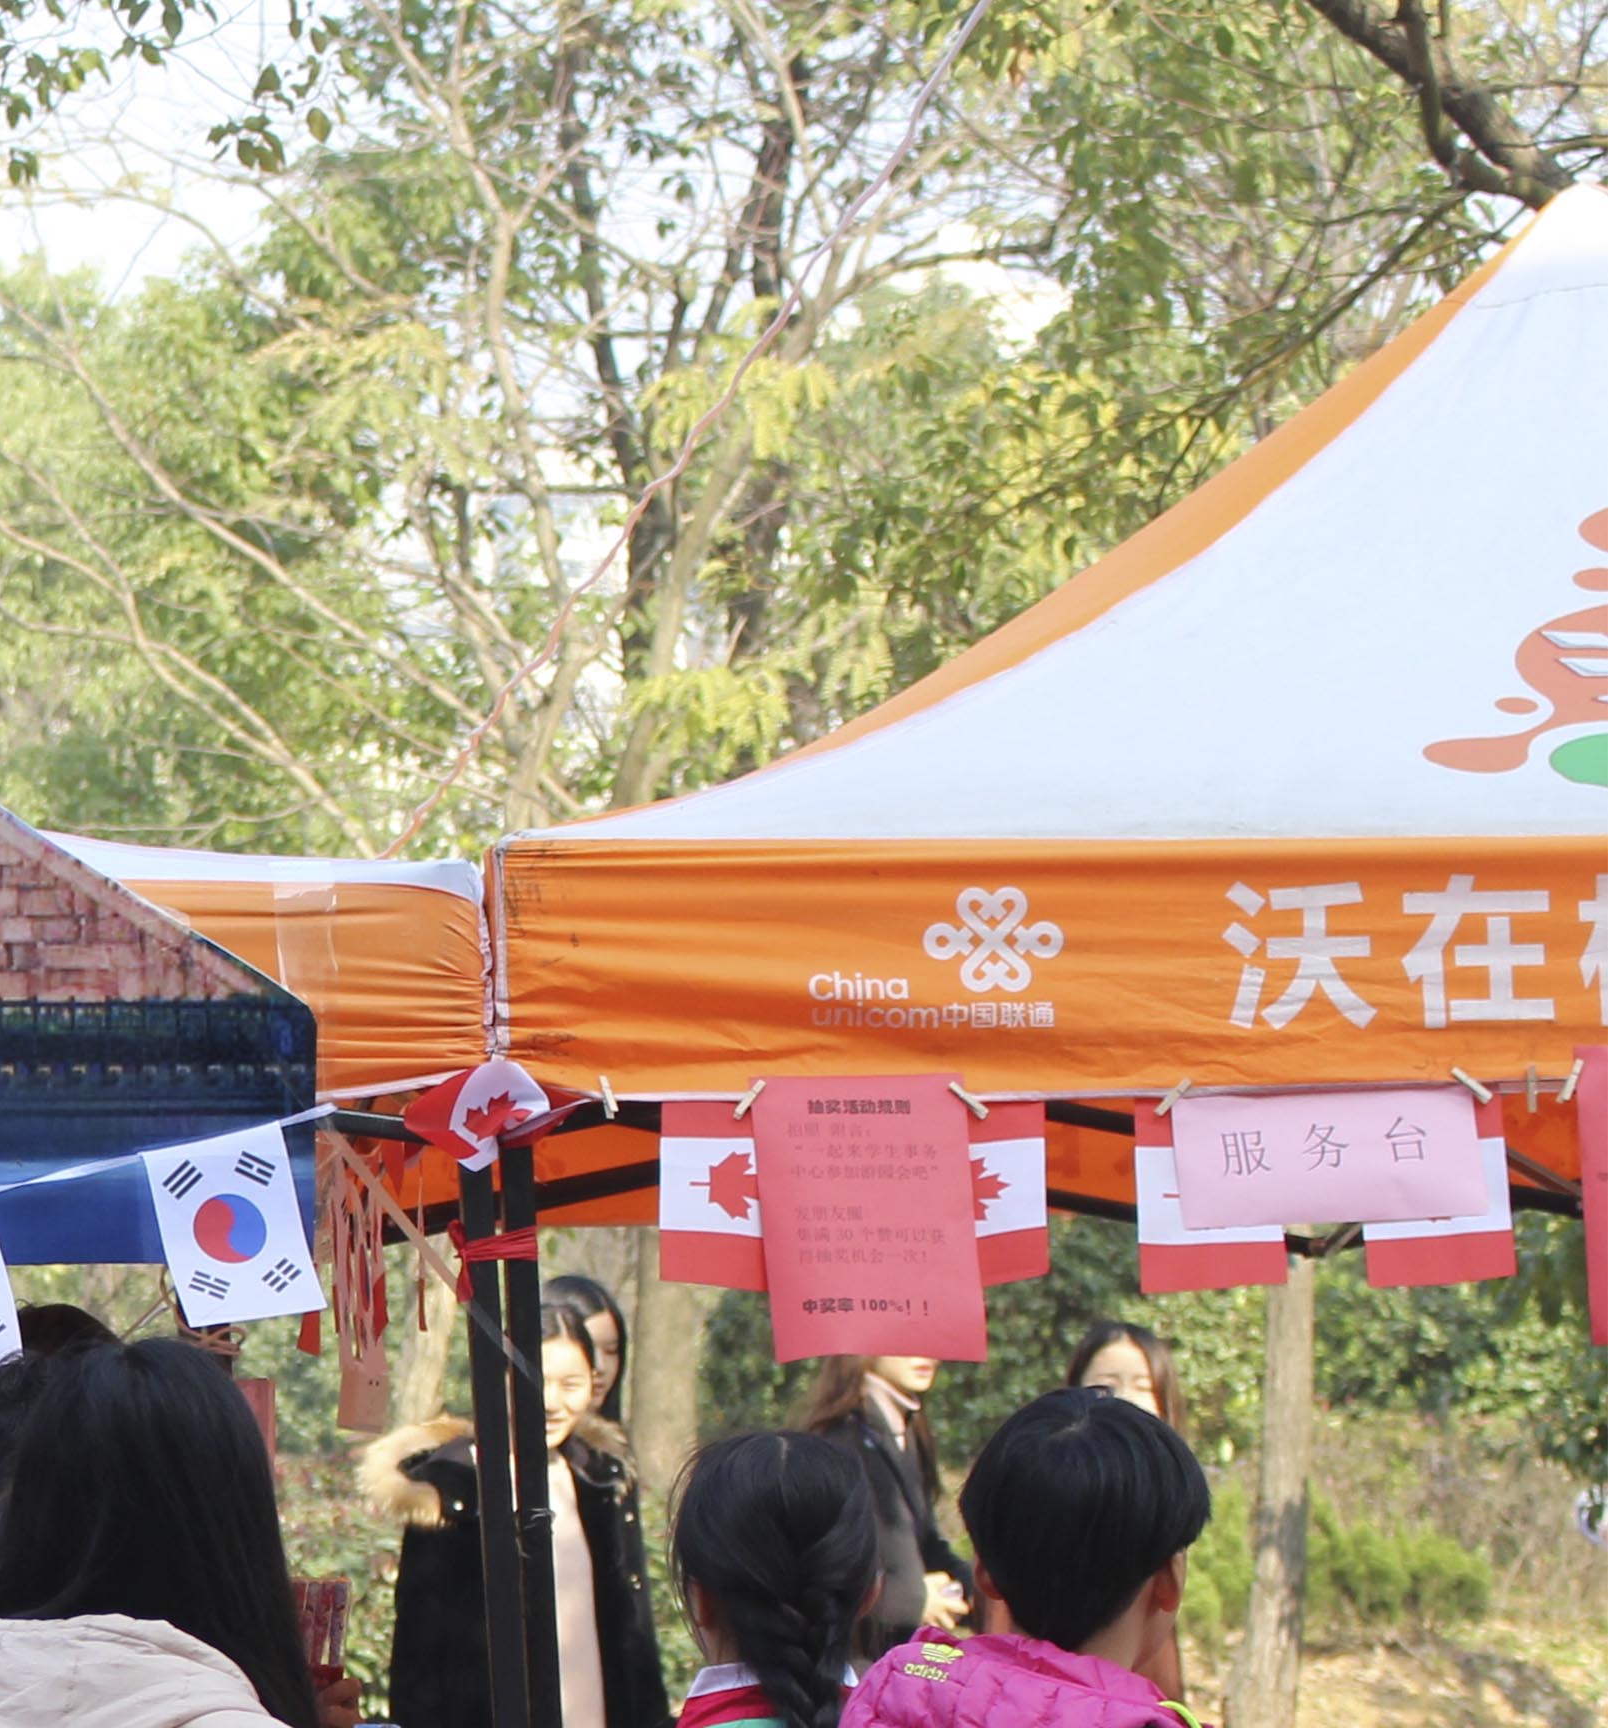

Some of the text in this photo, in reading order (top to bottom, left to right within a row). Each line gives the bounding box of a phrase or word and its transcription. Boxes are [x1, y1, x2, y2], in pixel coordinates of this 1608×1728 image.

[808, 971, 910, 1001] China
[811, 1003, 940, 1029] unicom
[942, 1001, 1056, 1029] 中国联通
[808, 1099, 912, 1115] 抽奖活动规则
[1220, 1115, 1427, 1177] 服务台
[904, 1662, 950, 1683] adidas
